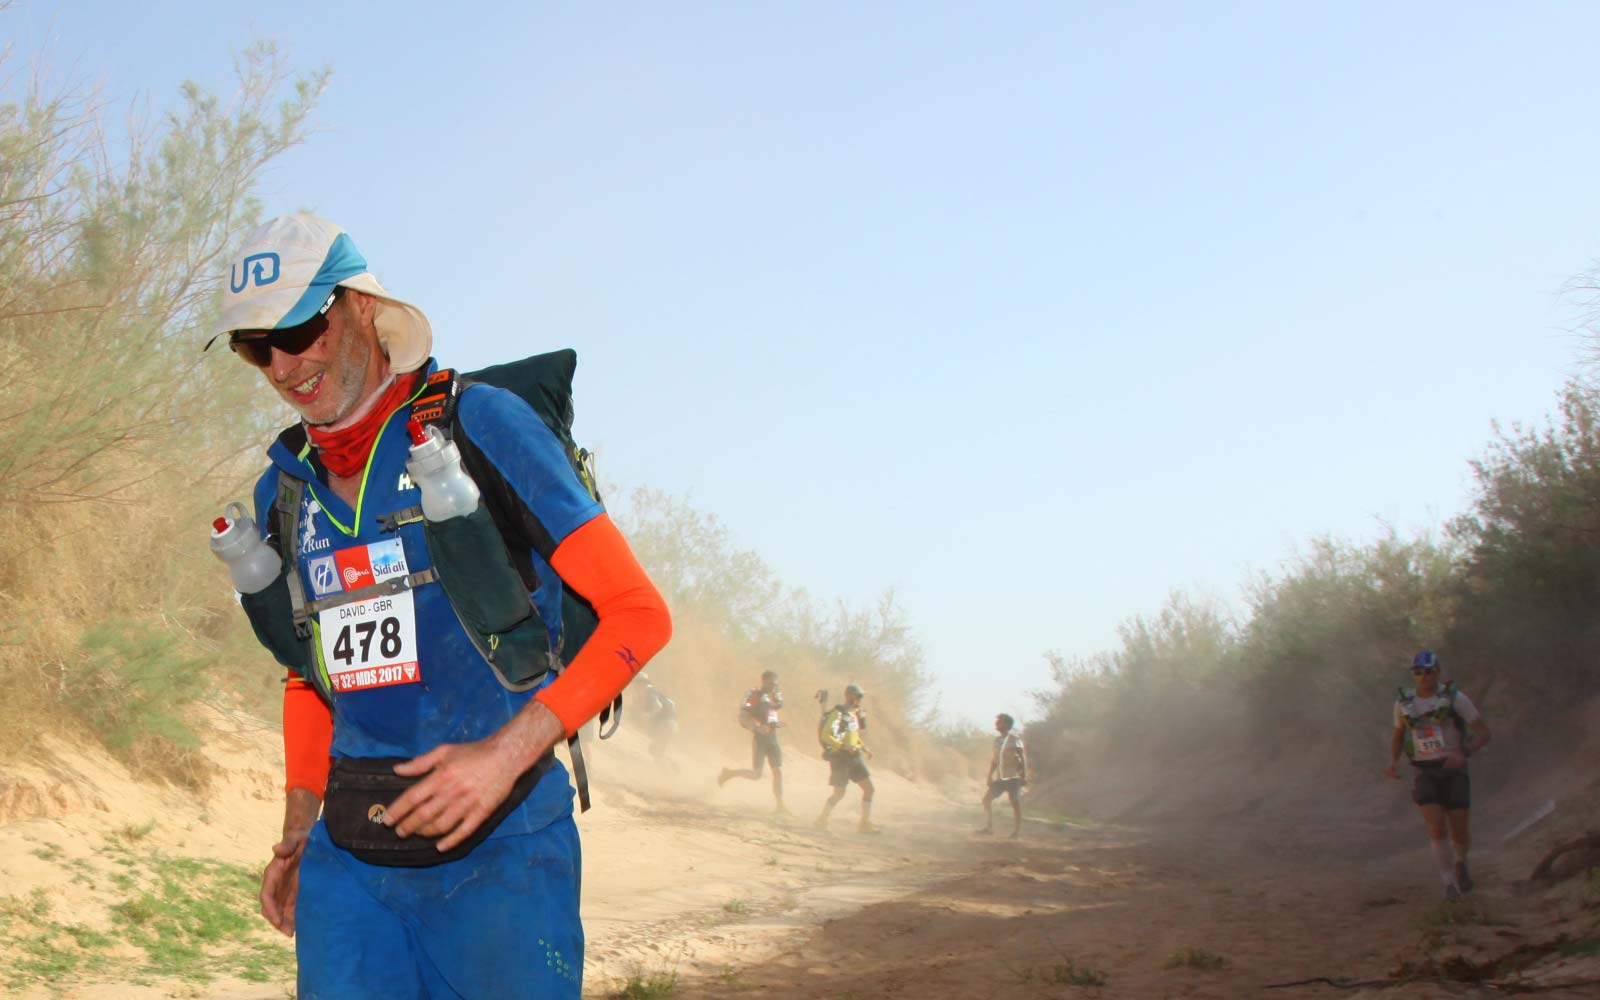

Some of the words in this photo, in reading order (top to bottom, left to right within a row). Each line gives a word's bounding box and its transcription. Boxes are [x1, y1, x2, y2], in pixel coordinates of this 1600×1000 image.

[373, 563, 392, 577] Sidi
[392, 561, 405, 573] ali
[340, 605, 366, 619] DAVID
[373, 599, 393, 613] GBR
[333, 616, 402, 666] 478
[356, 670, 378, 686] MDS
[378, 666, 402, 683] 2017
